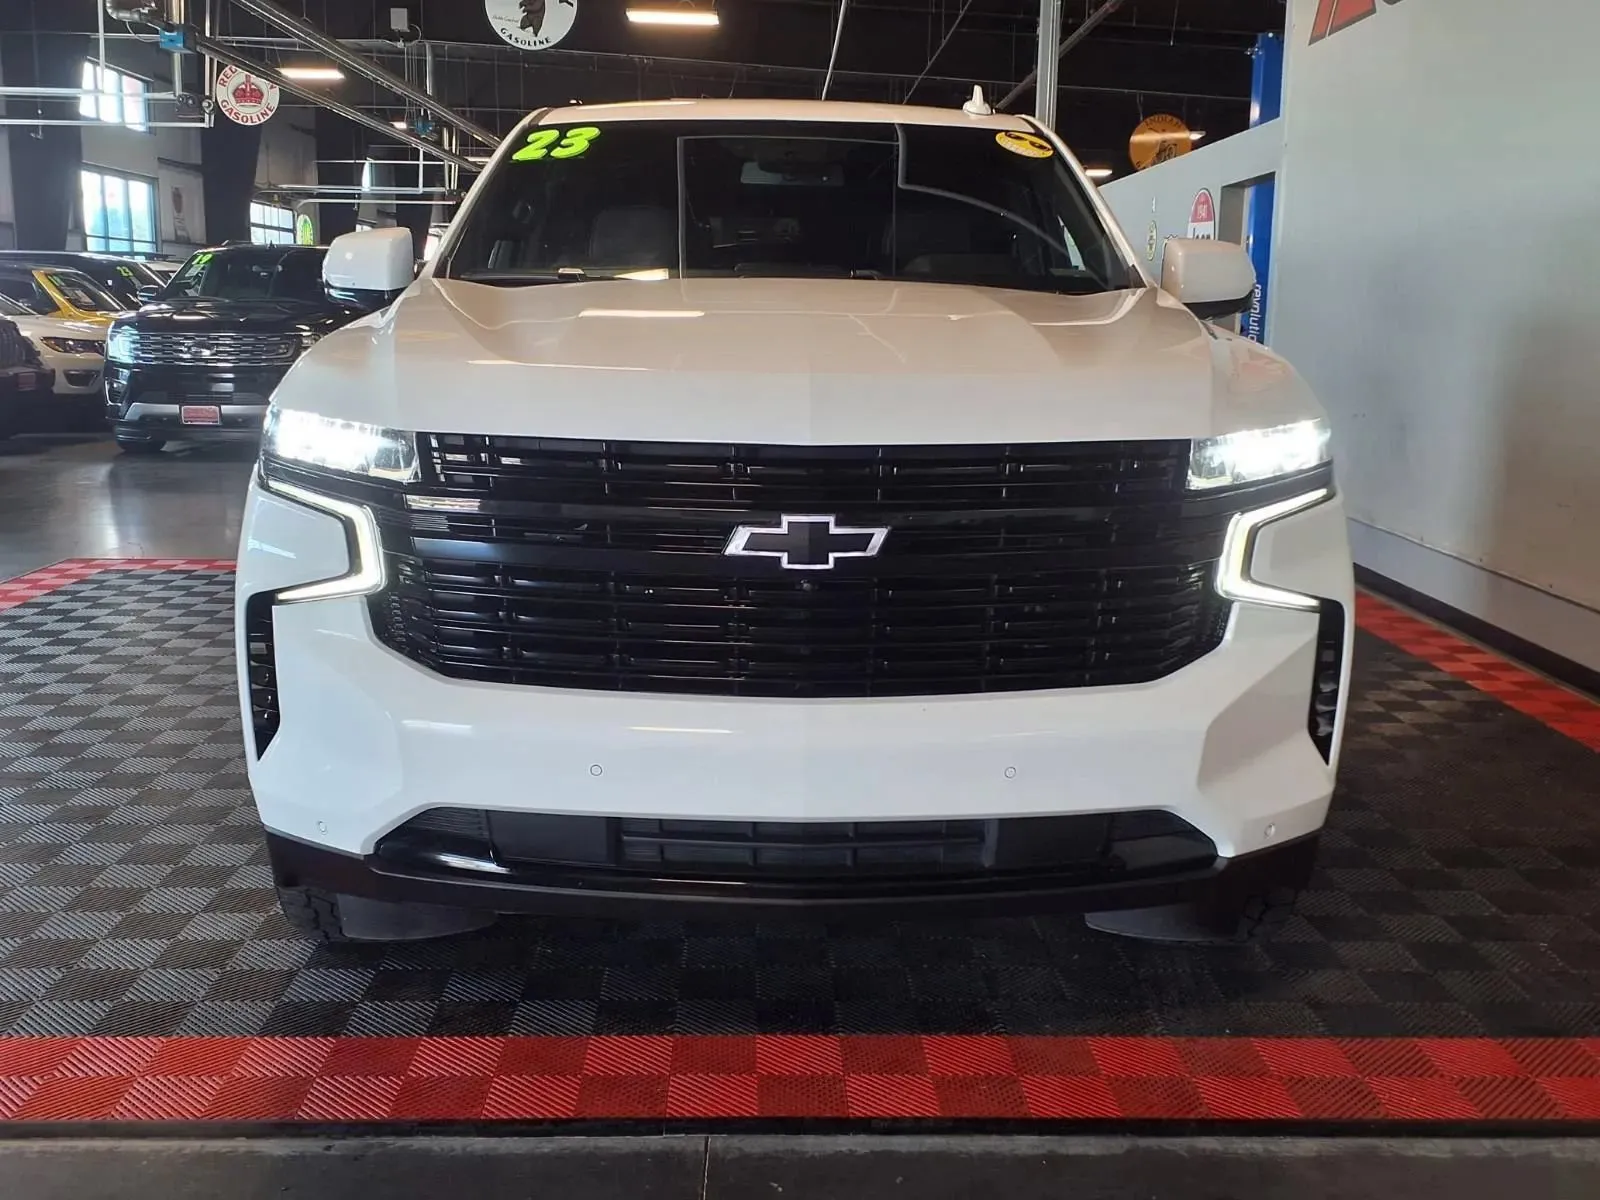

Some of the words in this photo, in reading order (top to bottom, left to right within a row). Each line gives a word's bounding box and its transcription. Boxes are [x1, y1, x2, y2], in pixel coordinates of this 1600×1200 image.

[500, 27, 552, 47] GASOLINE
[220, 99, 275, 124] GASOLINE
[511, 127, 601, 161] 23
[1248, 284, 1262, 343] revolutio
